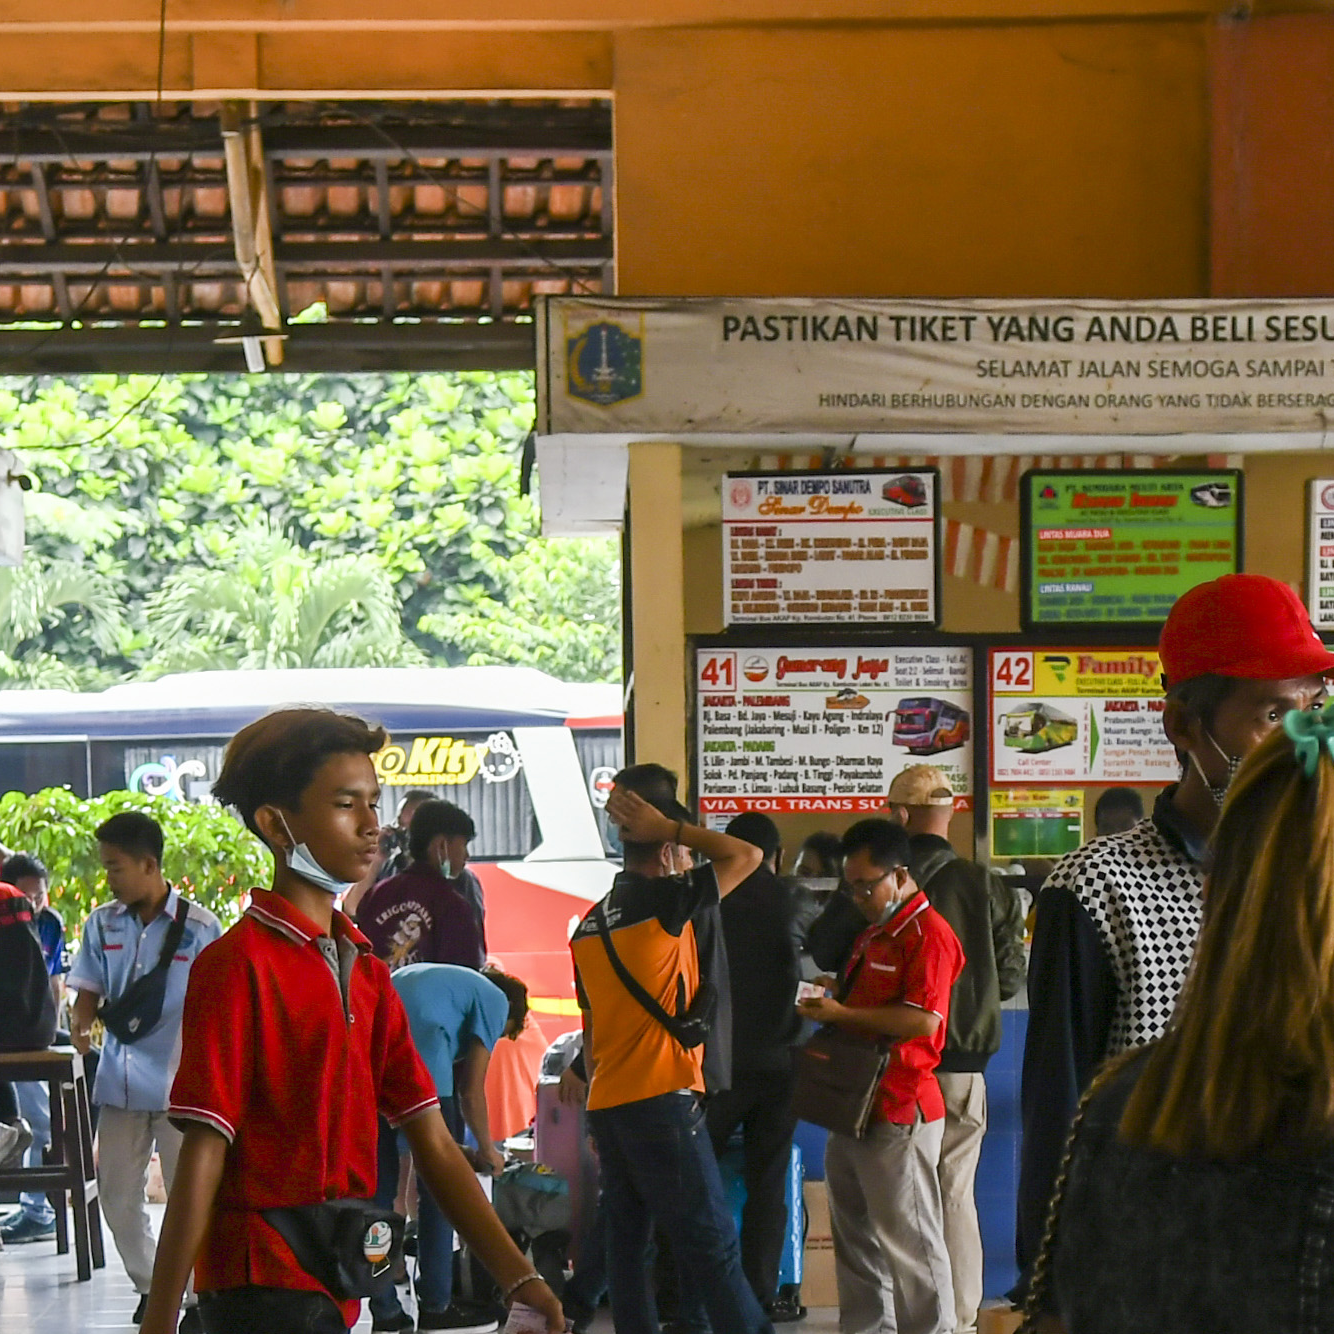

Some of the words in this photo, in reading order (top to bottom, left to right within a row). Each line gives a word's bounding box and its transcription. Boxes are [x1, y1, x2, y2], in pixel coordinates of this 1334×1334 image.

[722, 313, 879, 343] PASTIKAN
[889, 313, 976, 343] TIKET
[985, 313, 1076, 343] YANG
[1083, 313, 1179, 343] ANDA
[1189, 313, 1254, 342] BELI
[974, 358, 1073, 379] SELAMAT
[1076, 358, 1142, 380] JALAN
[1147, 358, 1241, 379] SEMOGA
[1245, 358, 1326, 379] SAMPAI
[818, 392, 887, 409] HINDARI
[890, 392, 1016, 409] BERHUBUNGAN
[1020, 392, 1090, 409] DENGAN
[1093, 392, 1154, 409] ORANG
[1156, 393, 1202, 409] YANG
[1205, 393, 1253, 409] TIDAK
[774, 480, 800, 495] SINAR
[801, 479, 831, 495] DEMPO
[700, 657, 734, 686] 41
[996, 656, 1031, 687] 42
[1077, 656, 1159, 679] Family
[407, 736, 489, 785] Kity
[703, 800, 738, 811] VIA
[743, 800, 773, 811] TOL
[786, 800, 854, 811] TRANS
